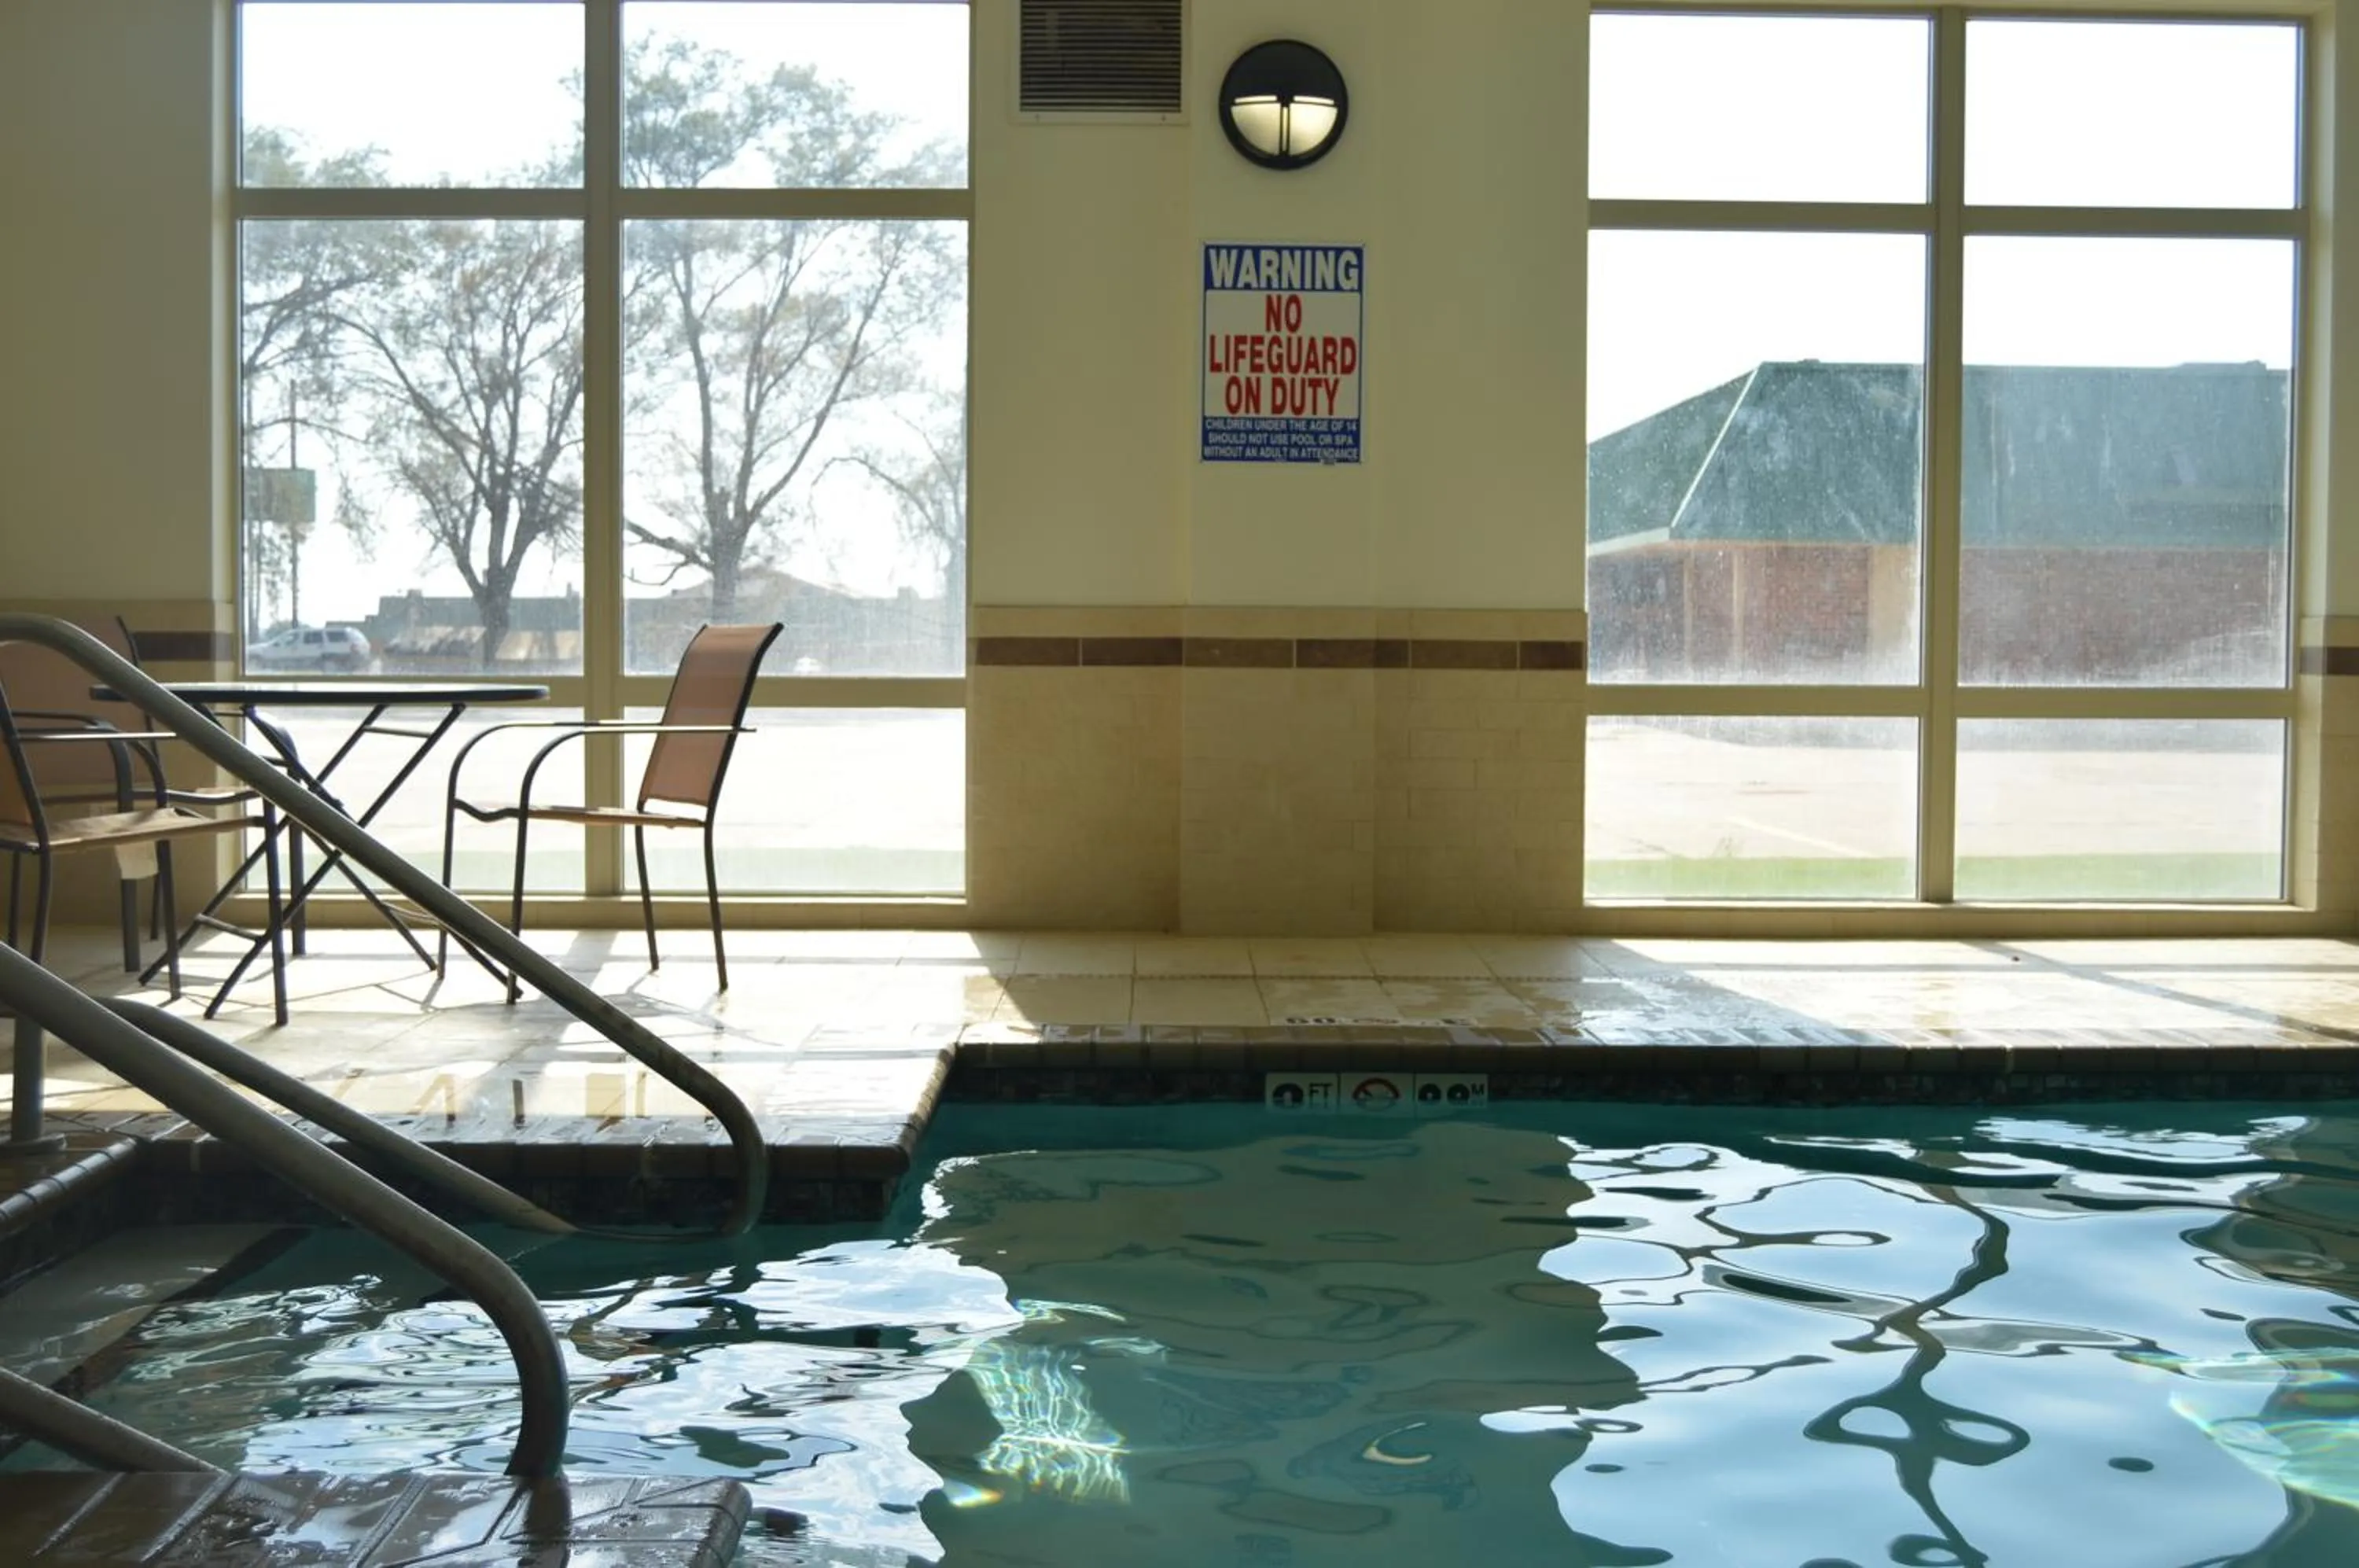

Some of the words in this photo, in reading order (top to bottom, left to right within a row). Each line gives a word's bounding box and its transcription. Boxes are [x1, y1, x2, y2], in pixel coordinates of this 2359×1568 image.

[1208, 248, 1359, 289] WARNING
[1265, 294, 1302, 333] NO
[1209, 335, 1356, 375] LIFEGUARD
[1225, 376, 1260, 415] ON
[1272, 377, 1339, 415] DUTY
[1205, 419, 1252, 429] CHILDREN
[1255, 419, 1286, 430] UNDER
[1289, 420, 1306, 430] THE
[1310, 420, 1328, 430] AGE
[1330, 421, 1343, 431] OF
[1209, 432, 1246, 444] SHOULD
[1249, 433, 1268, 444] NOT
[1270, 433, 1288, 444] USE
[1290, 434, 1315, 445] POOL
[1319, 434, 1332, 445] OR
[1334, 434, 1352, 445] SPA
[1205, 446, 1242, 458] WITHOUT
[1245, 447, 1257, 458] AN
[1260, 447, 1287, 458] ADULT
[1290, 447, 1299, 458] IN
[1301, 447, 1358, 459] ATTENDANCE
[1308, 1082, 1333, 1100] FT
